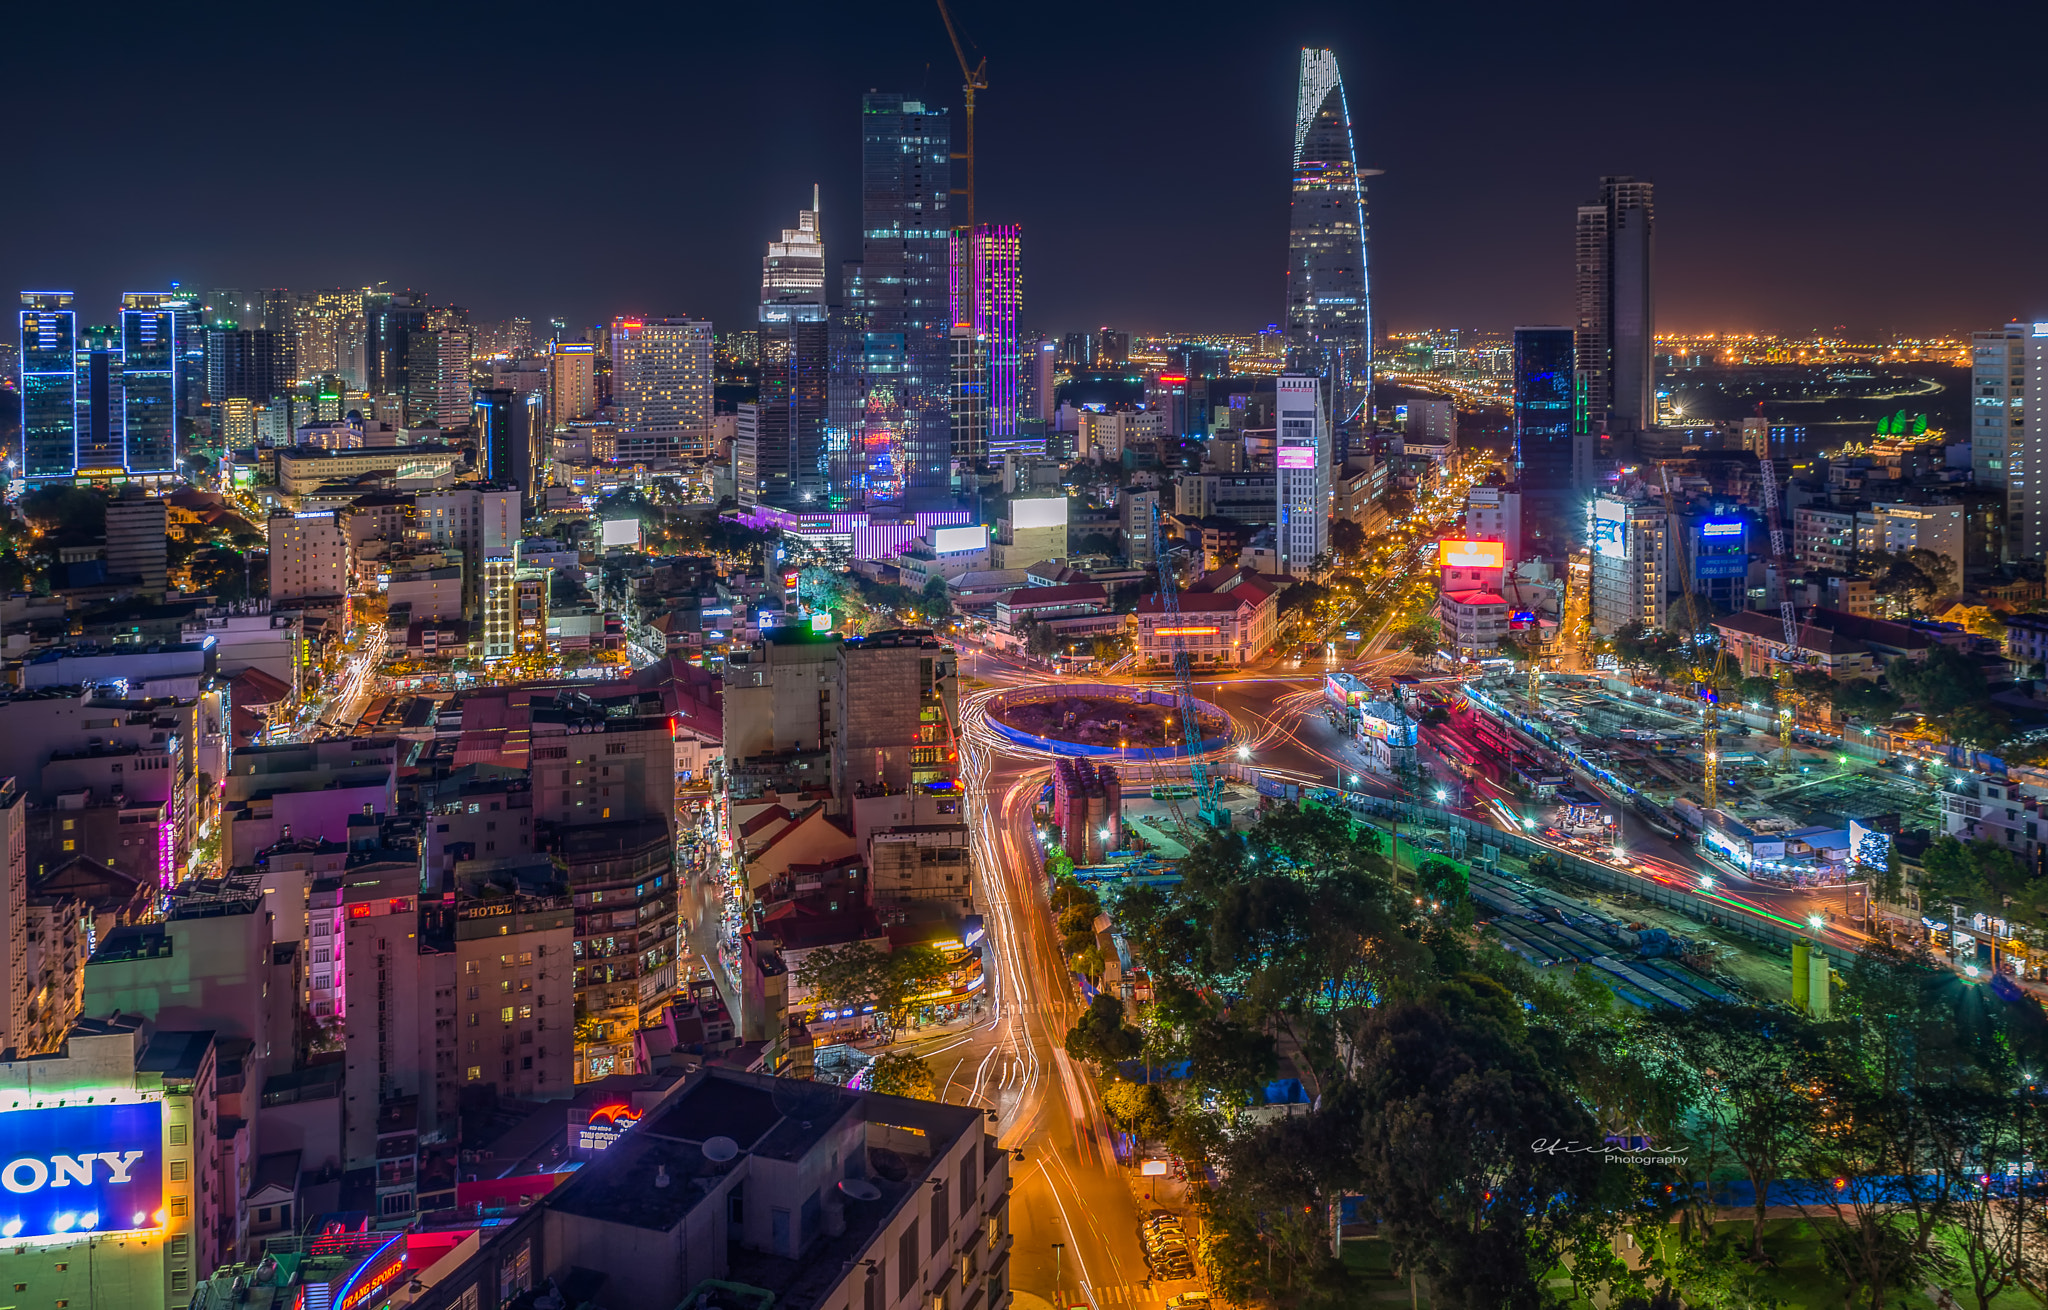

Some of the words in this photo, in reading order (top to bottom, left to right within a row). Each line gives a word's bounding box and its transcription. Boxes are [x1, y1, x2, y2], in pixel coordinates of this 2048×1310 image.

[469, 904, 513, 918] HOTEL
[594, 1132, 621, 1141] SPORT
[1, 1150, 144, 1194] ONY
[341, 1282, 370, 1310] TRANG
[370, 1260, 402, 1290] SPORTS
